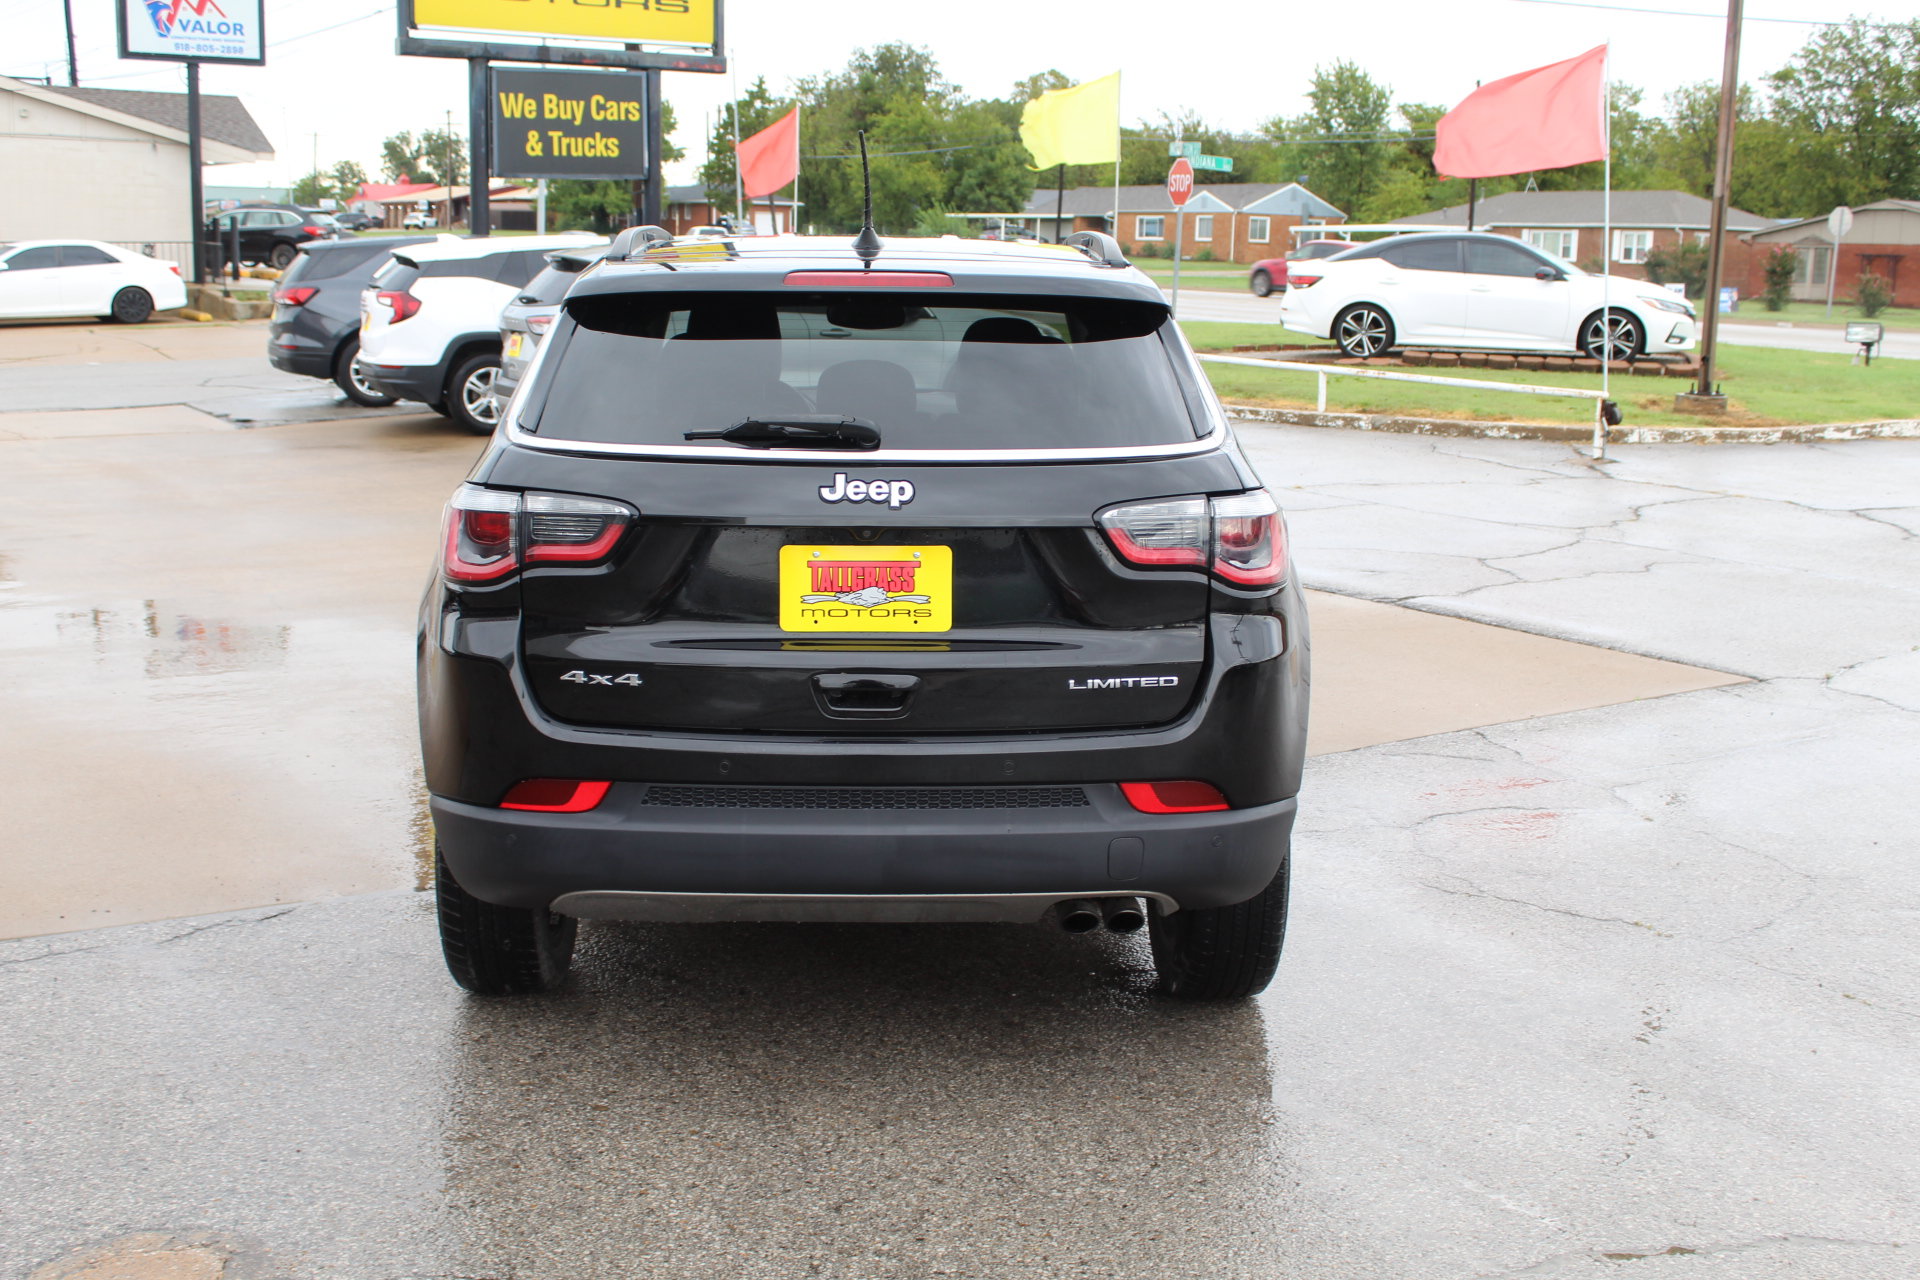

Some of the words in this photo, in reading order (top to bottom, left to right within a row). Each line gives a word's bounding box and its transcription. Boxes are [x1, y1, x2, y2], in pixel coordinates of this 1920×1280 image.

[178, 18, 245, 36] VALOR
[499, 92, 537, 119] We
[543, 94, 585, 126] Buy
[590, 94, 641, 122] Cars
[525, 130, 543, 157] &
[547, 130, 620, 158] Trucks
[1170, 174, 1191, 192] STOP
[819, 472, 915, 510] Jeep
[807, 561, 921, 593] TALLGRASS
[801, 608, 932, 618] MOTORS
[559, 670, 643, 687] 4x4
[1068, 676, 1179, 690] LIMITED
